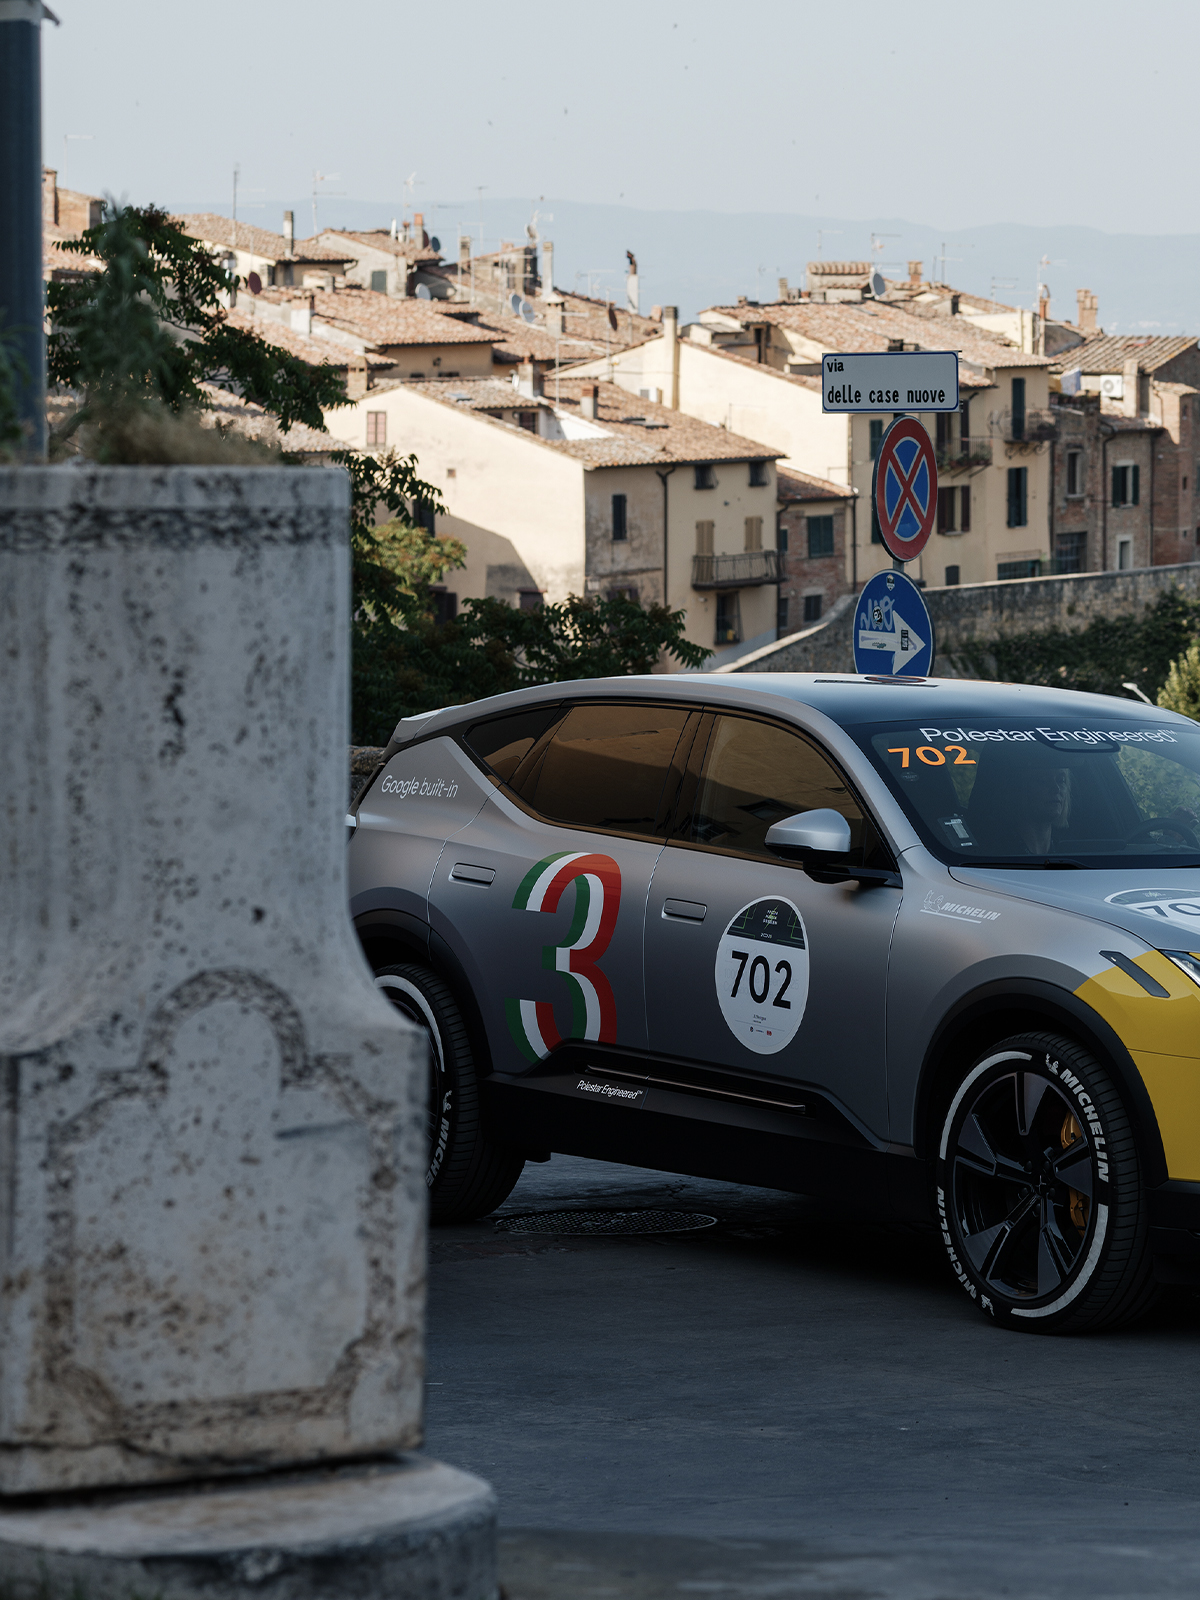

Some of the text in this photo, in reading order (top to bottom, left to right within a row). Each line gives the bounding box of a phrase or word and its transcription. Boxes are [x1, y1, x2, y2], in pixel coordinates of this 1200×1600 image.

[827, 359, 844, 372] via
[827, 384, 945, 403] delle case nuove
[919, 727, 1036, 742] Polestar
[887, 745, 977, 768] 702
[381, 774, 459, 799] Google built-in
[941, 902, 1001, 921] MICHELIN
[504, 851, 622, 1064] 3
[730, 950, 792, 1010] 702
[576, 1079, 603, 1093] Polestar
[1059, 1068, 1109, 1183] MICHELIN
[936, 1185, 977, 1300] MICHELIN
